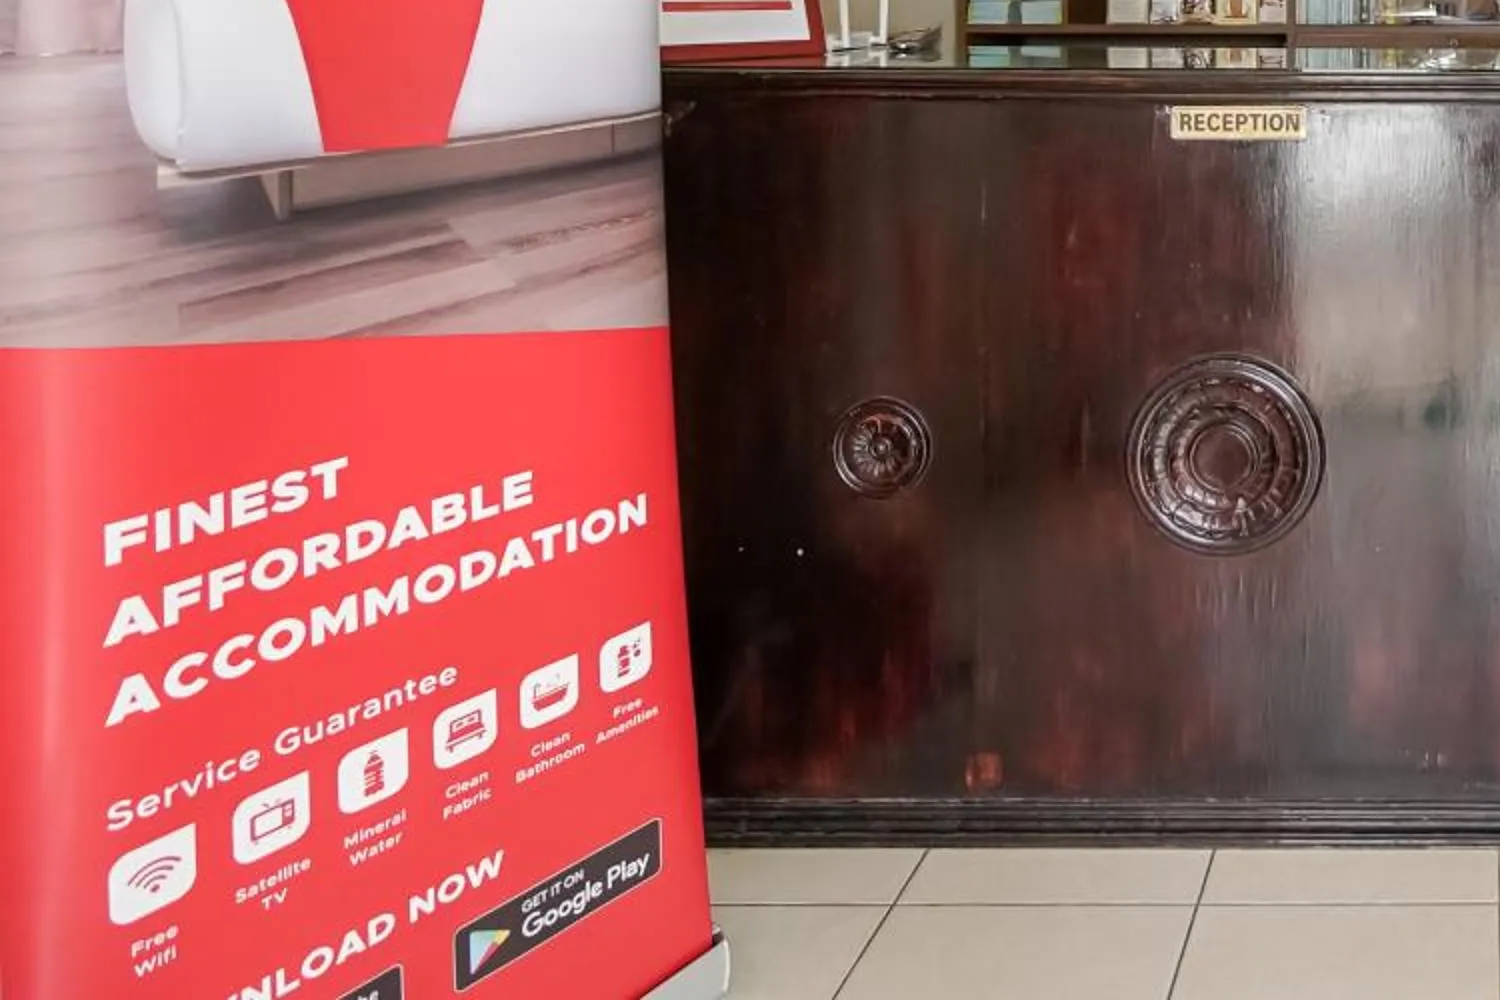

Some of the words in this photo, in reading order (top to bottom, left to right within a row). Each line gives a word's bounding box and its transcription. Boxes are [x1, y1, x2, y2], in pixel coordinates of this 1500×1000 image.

[1179, 113, 1300, 132] RECEPTION
[104, 456, 349, 567] FINEST
[103, 471, 534, 648] AFFORDABLE
[104, 493, 649, 728] ACCOMMODATION
[596, 706, 660, 744] Amenities
[612, 698, 643, 719] Free
[107, 749, 261, 832] Service
[274, 666, 460, 756] Guarantee
[515, 743, 586, 784] Bathroom
[531, 732, 571, 757] Clean
[443, 788, 492, 820] Fabric
[445, 771, 490, 799] Clean
[344, 808, 407, 849] Mineral
[350, 831, 403, 866] Water
[235, 858, 312, 903] Satellite
[261, 888, 288, 910] TV
[521, 888, 549, 913] GET
[551, 880, 563, 899] IT
[564, 868, 585, 889] ON
[521, 880, 603, 938] Google
[607, 853, 650, 888] Play
[131, 925, 179, 958] Free
[227, 913, 396, 1000] NLOAD
[408, 849, 504, 923] NOW
[134, 945, 177, 977] Wifi
